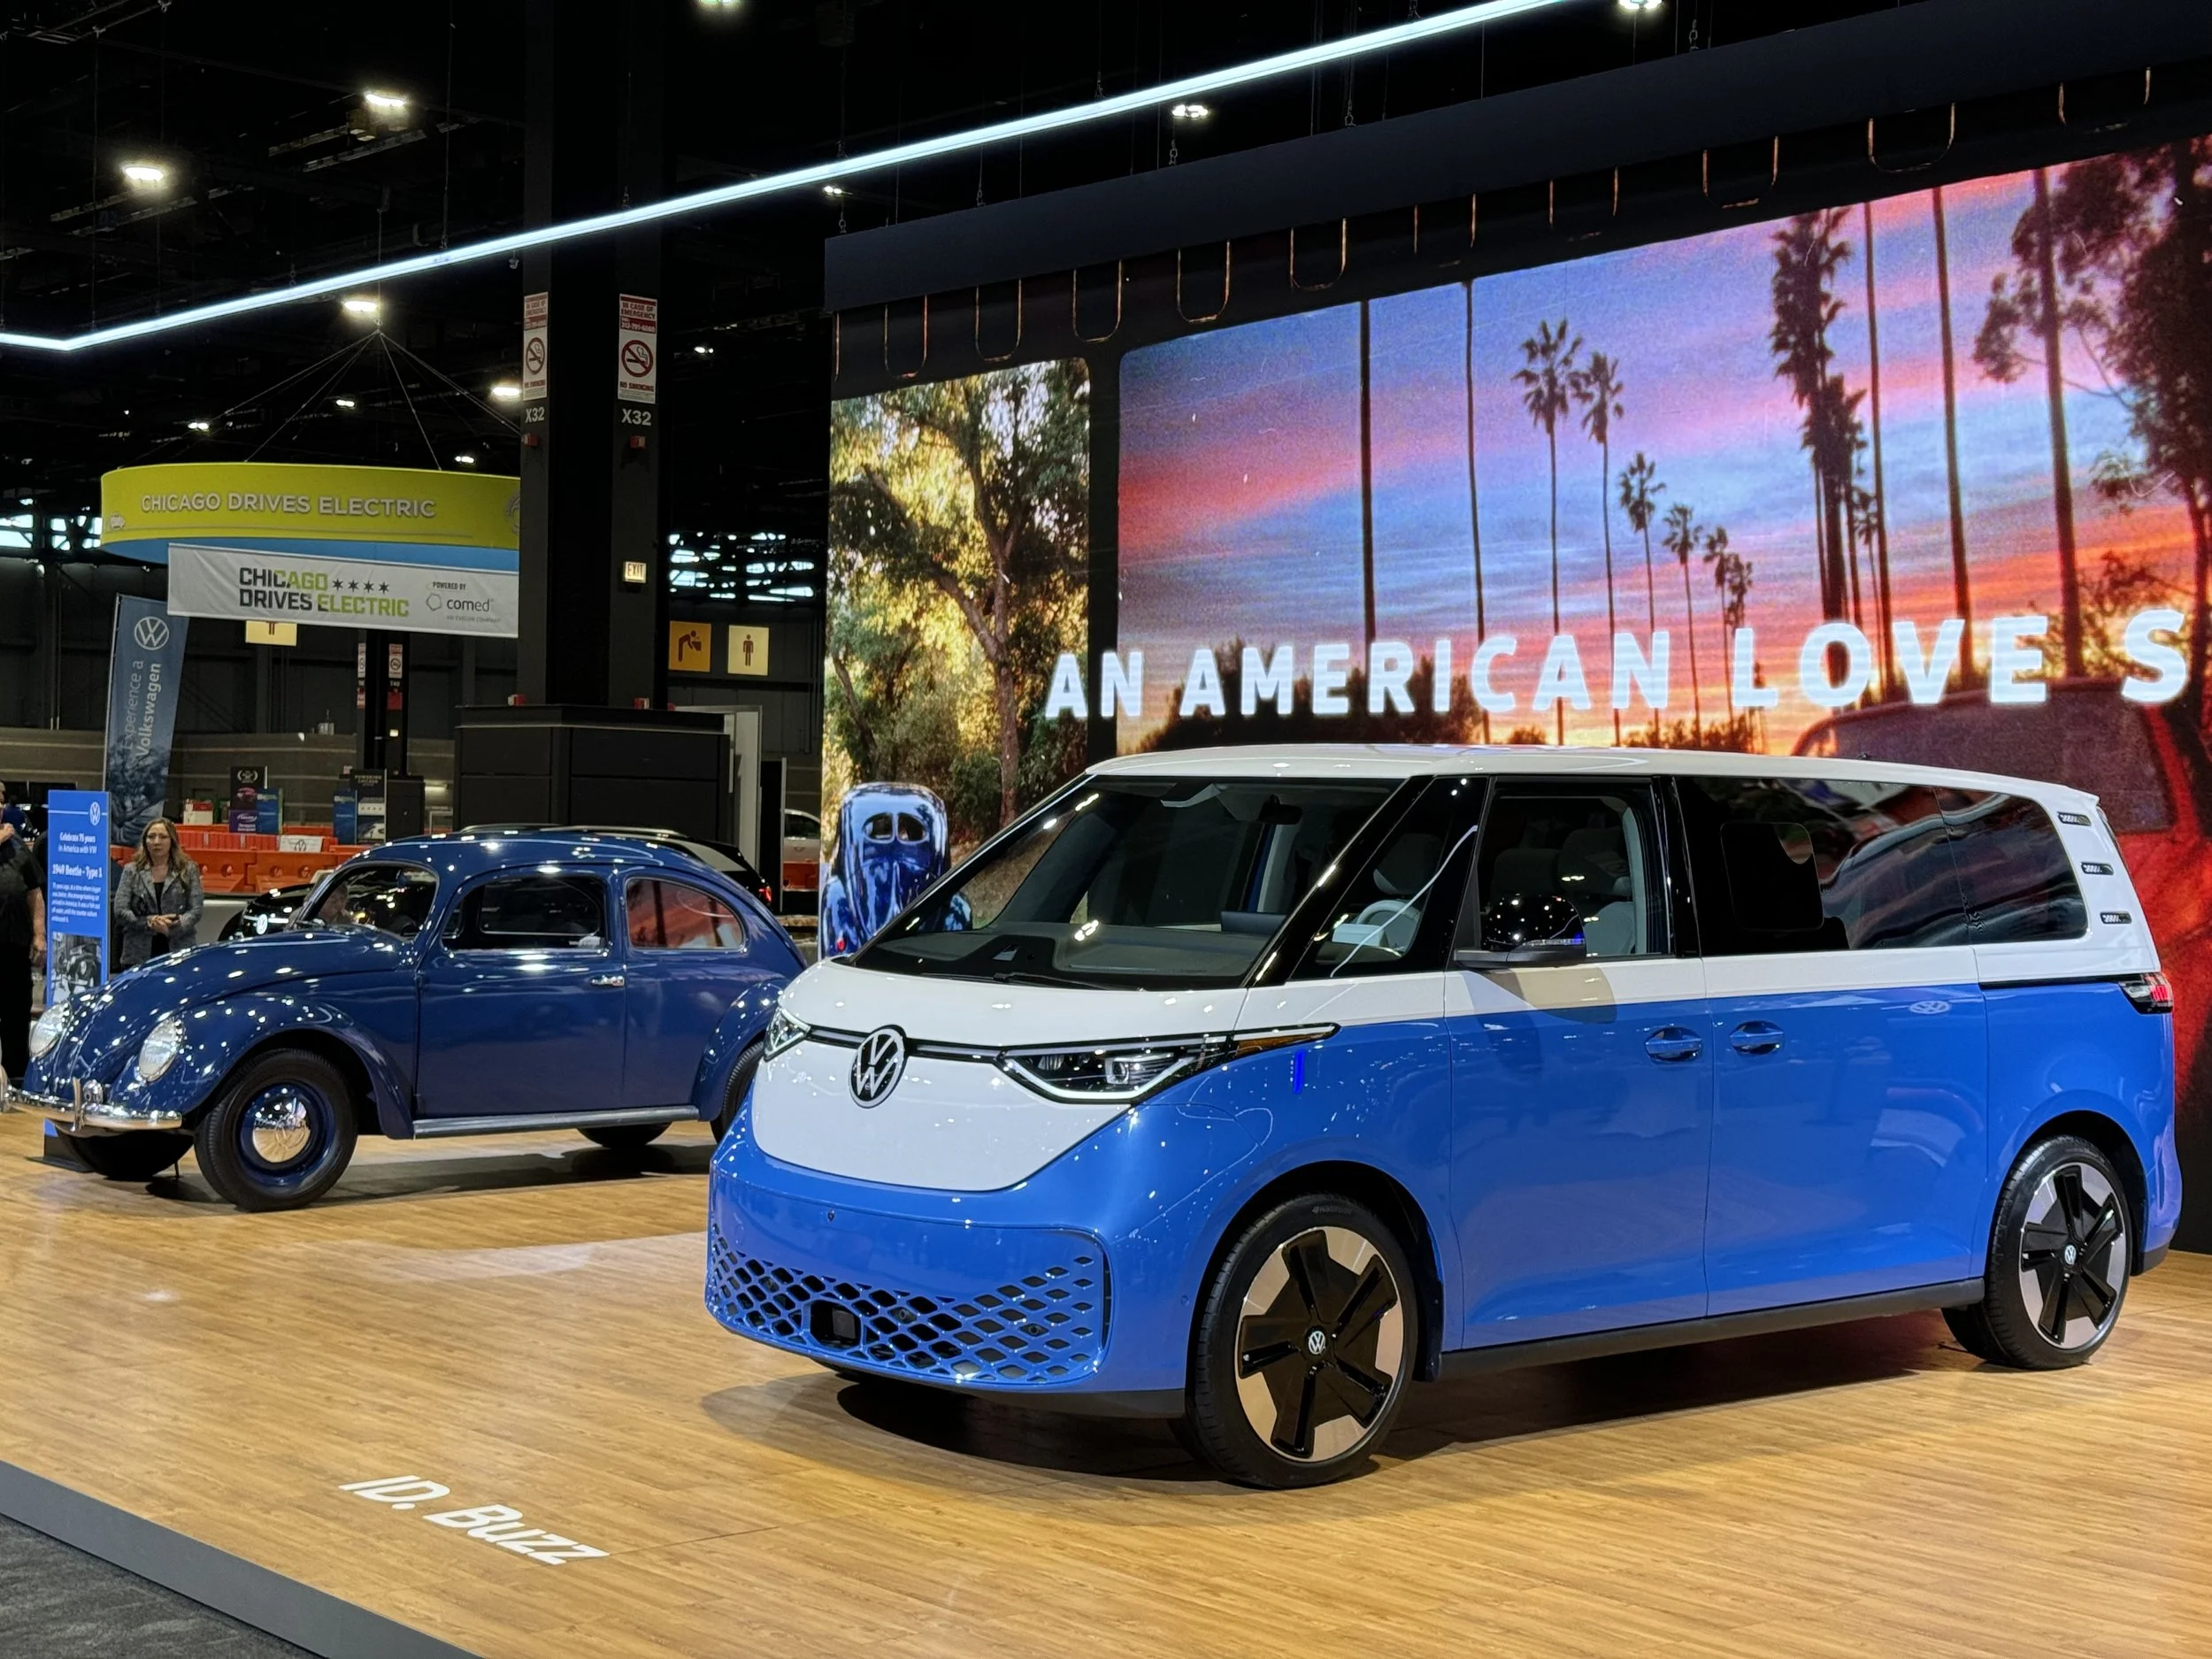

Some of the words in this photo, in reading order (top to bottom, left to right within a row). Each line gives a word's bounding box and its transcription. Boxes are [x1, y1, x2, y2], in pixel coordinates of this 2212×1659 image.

[621, 309, 656, 319] EMERGENCY
[629, 382, 654, 392] SMOKING
[525, 407, 544, 423] X32
[622, 408, 651, 426] X32
[141, 492, 220, 512] CHICAGO
[227, 493, 311, 514] DRIVES
[319, 496, 436, 518] ELECTRIC
[240, 567, 328, 590] CHICAGO
[627, 563, 643, 577] EXIT
[433, 581, 458, 590] POWERED
[240, 588, 312, 611] DRIVES
[318, 594, 409, 617] ELECTRIC
[447, 598, 490, 612] comed
[134, 616, 170, 650] VW
[1045, 650, 1144, 718] AN
[1179, 631, 1671, 717] AMERICAN
[1731, 615, 2049, 709] LOVE
[2121, 608, 2188, 704] S
[120, 672, 142, 750] Experience
[133, 660, 144, 670] a
[135, 664, 162, 757] Volkswagen
[65, 864, 82, 877] Beetle
[85, 865, 98, 879] Type
[849, 1025, 905, 1108] VW
[1307, 1329, 1326, 1356] VW
[338, 1475, 450, 1510] ID.
